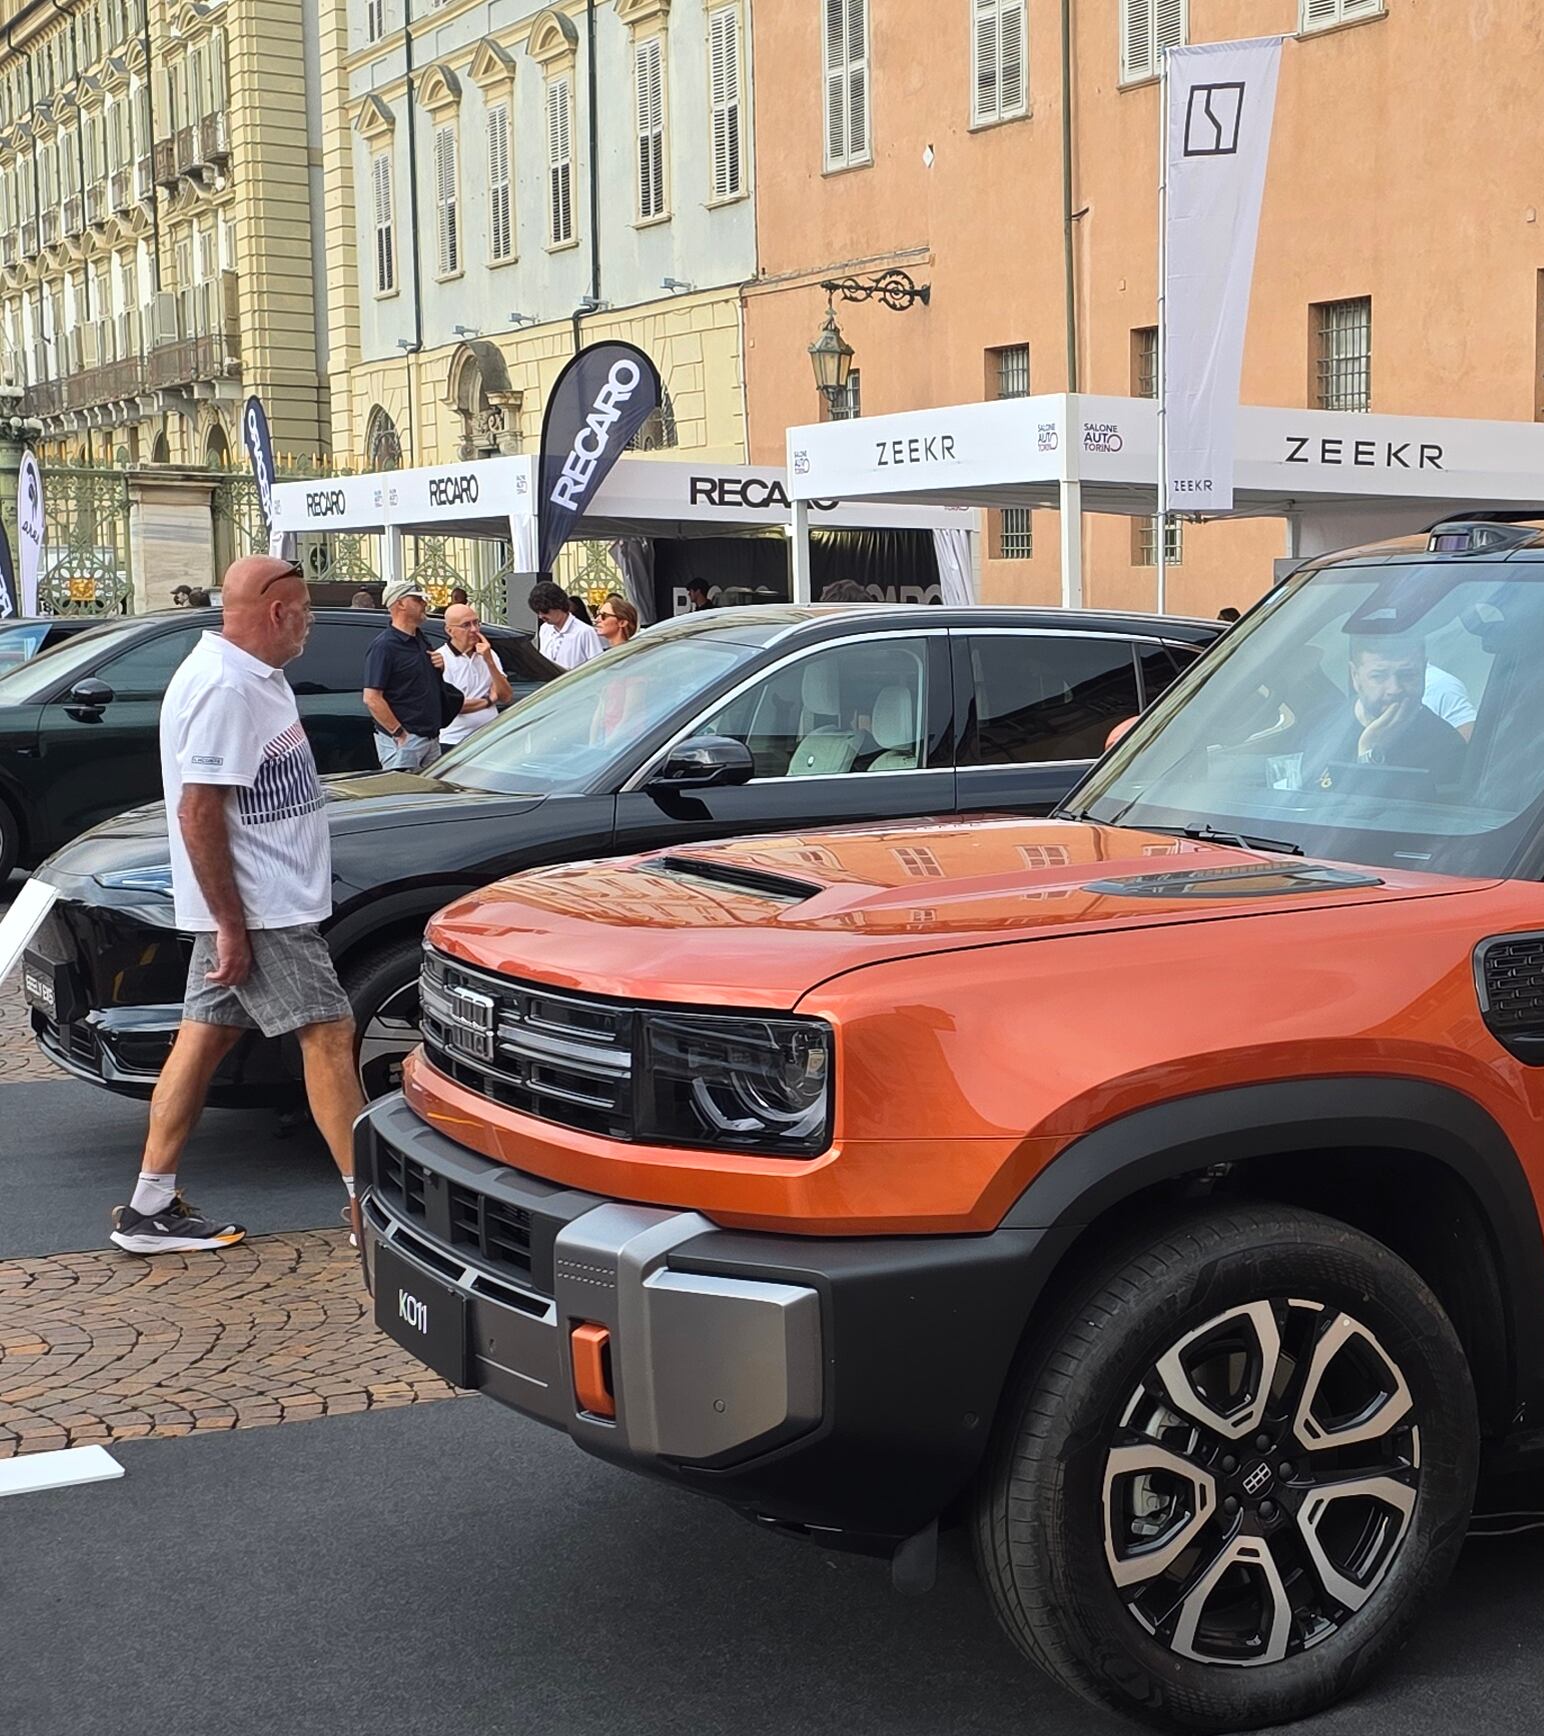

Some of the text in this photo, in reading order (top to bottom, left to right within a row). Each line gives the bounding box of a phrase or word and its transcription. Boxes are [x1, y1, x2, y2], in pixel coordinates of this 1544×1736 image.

[550, 359, 640, 511] RECARO
[1084, 423, 1118, 433] SALONE
[1084, 432, 1123, 449] AUTO
[876, 435, 955, 466] ZEEKR
[1285, 437, 1443, 469] ZEEKR
[429, 474, 478, 507] RECARO
[690, 477, 839, 511] RECA
[1174, 480, 1212, 492] ZEEKR
[306, 489, 345, 517] RECARO
